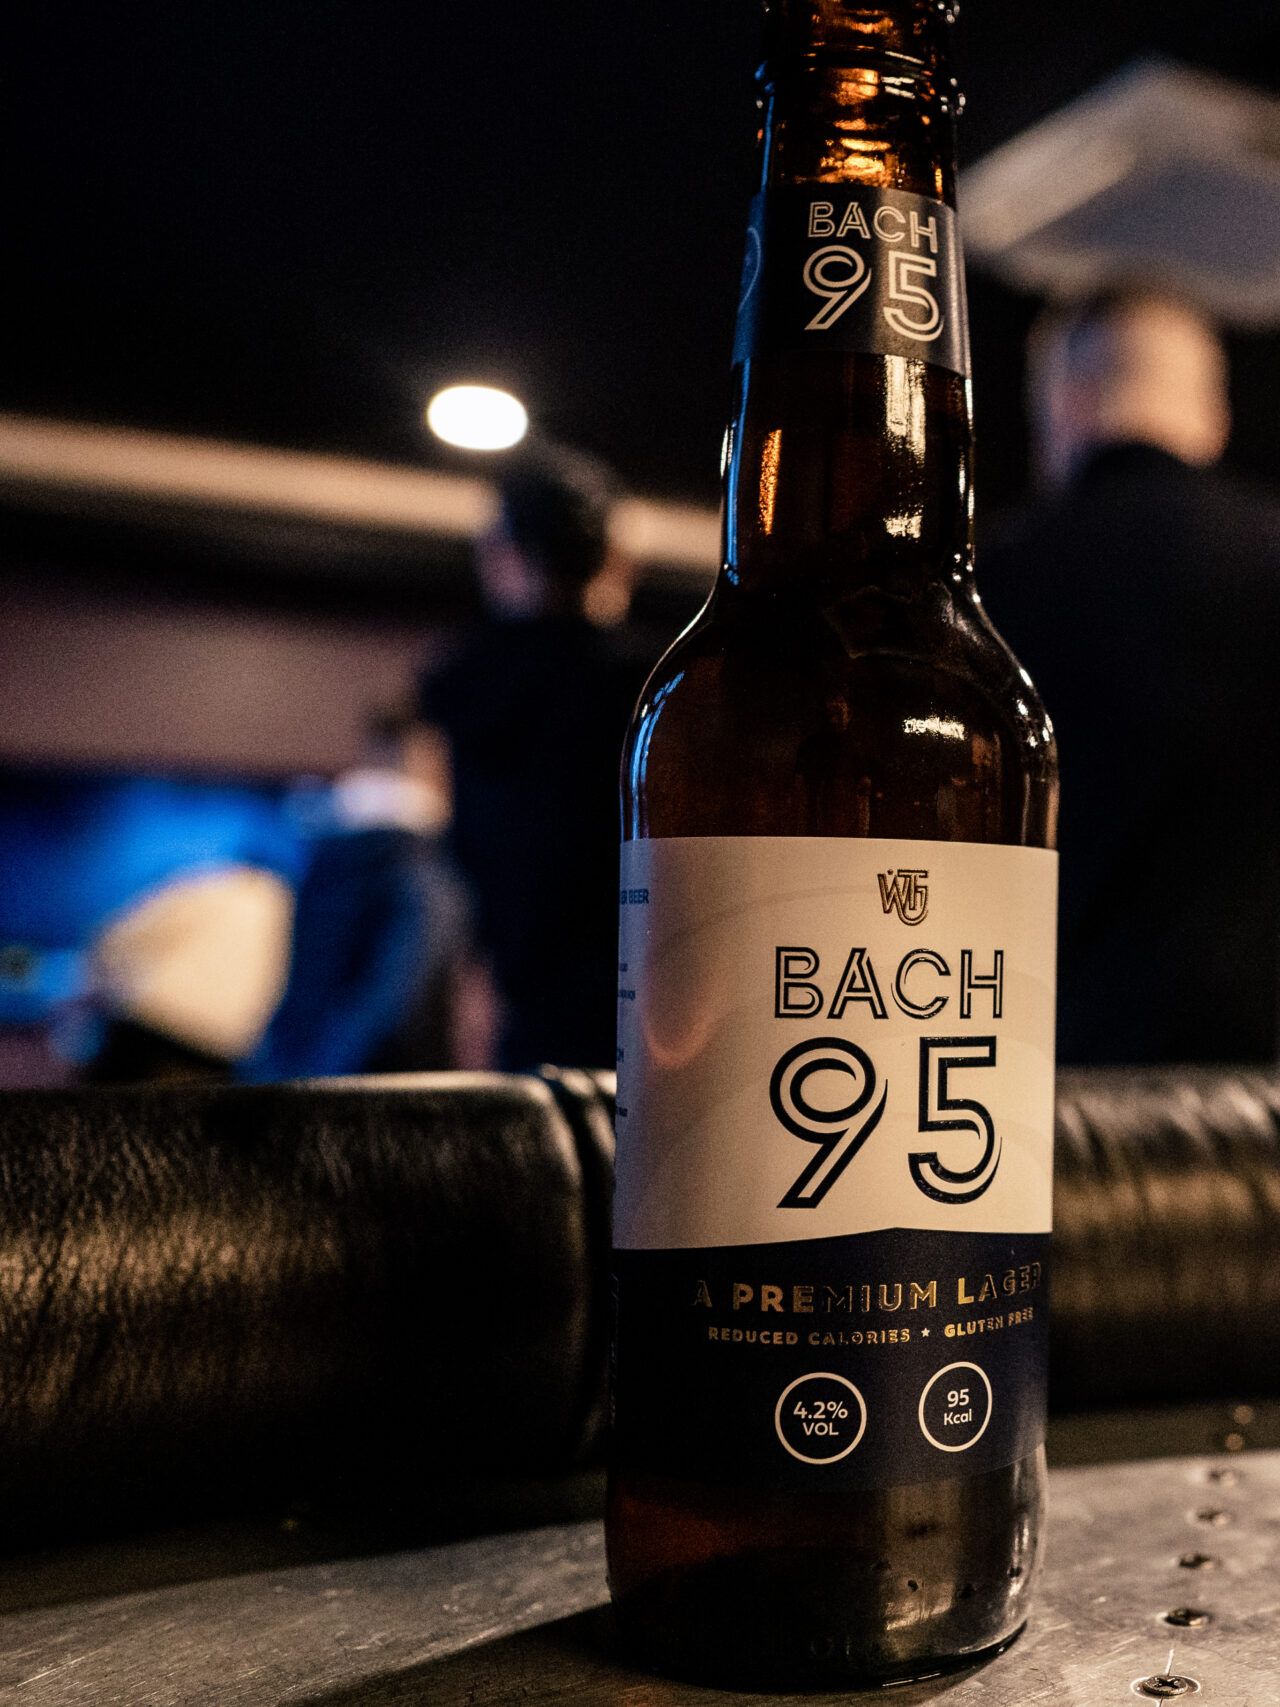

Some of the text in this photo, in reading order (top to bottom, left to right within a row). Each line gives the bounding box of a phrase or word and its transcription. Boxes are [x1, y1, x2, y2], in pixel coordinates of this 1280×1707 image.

[808, 201, 938, 254] BACH
[803, 245, 944, 342] 95
[775, 946, 1004, 1019] BACH
[769, 1036, 1002, 1209] 95
[692, 1262, 1042, 1313] A PREMIUM LAGER
[708, 1306, 1034, 1346] REDUCED CALORIES GLUTEN FREE
[793, 1401, 849, 1420] 4.2%
[943, 1408, 973, 1426] Kcal
[947, 1388, 970, 1408] 95
[802, 1422, 840, 1436] VOL
